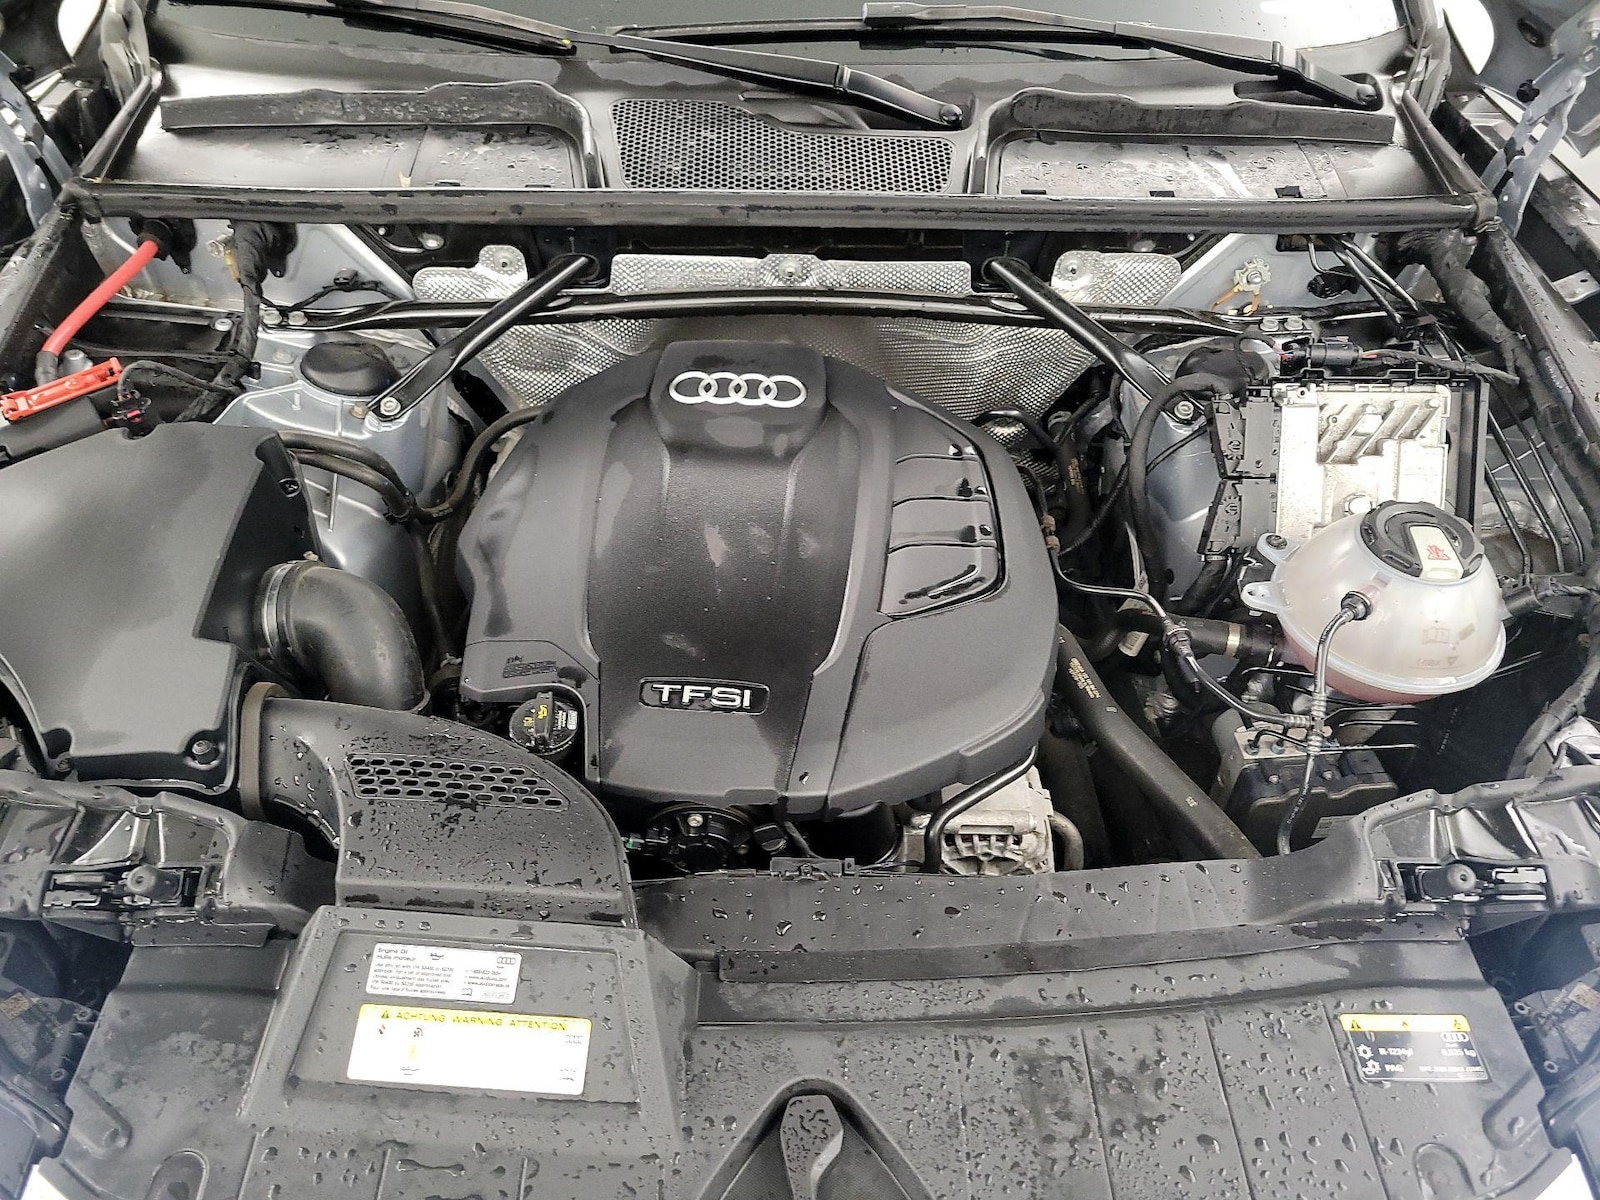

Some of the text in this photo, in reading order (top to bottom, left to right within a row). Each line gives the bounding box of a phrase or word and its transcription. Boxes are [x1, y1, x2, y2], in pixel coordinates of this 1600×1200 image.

[651, 684, 752, 709] TFSI
[377, 947, 399, 955] Engine
[396, 1011, 566, 1031] ACHTUNG WARNING ATTENTION
